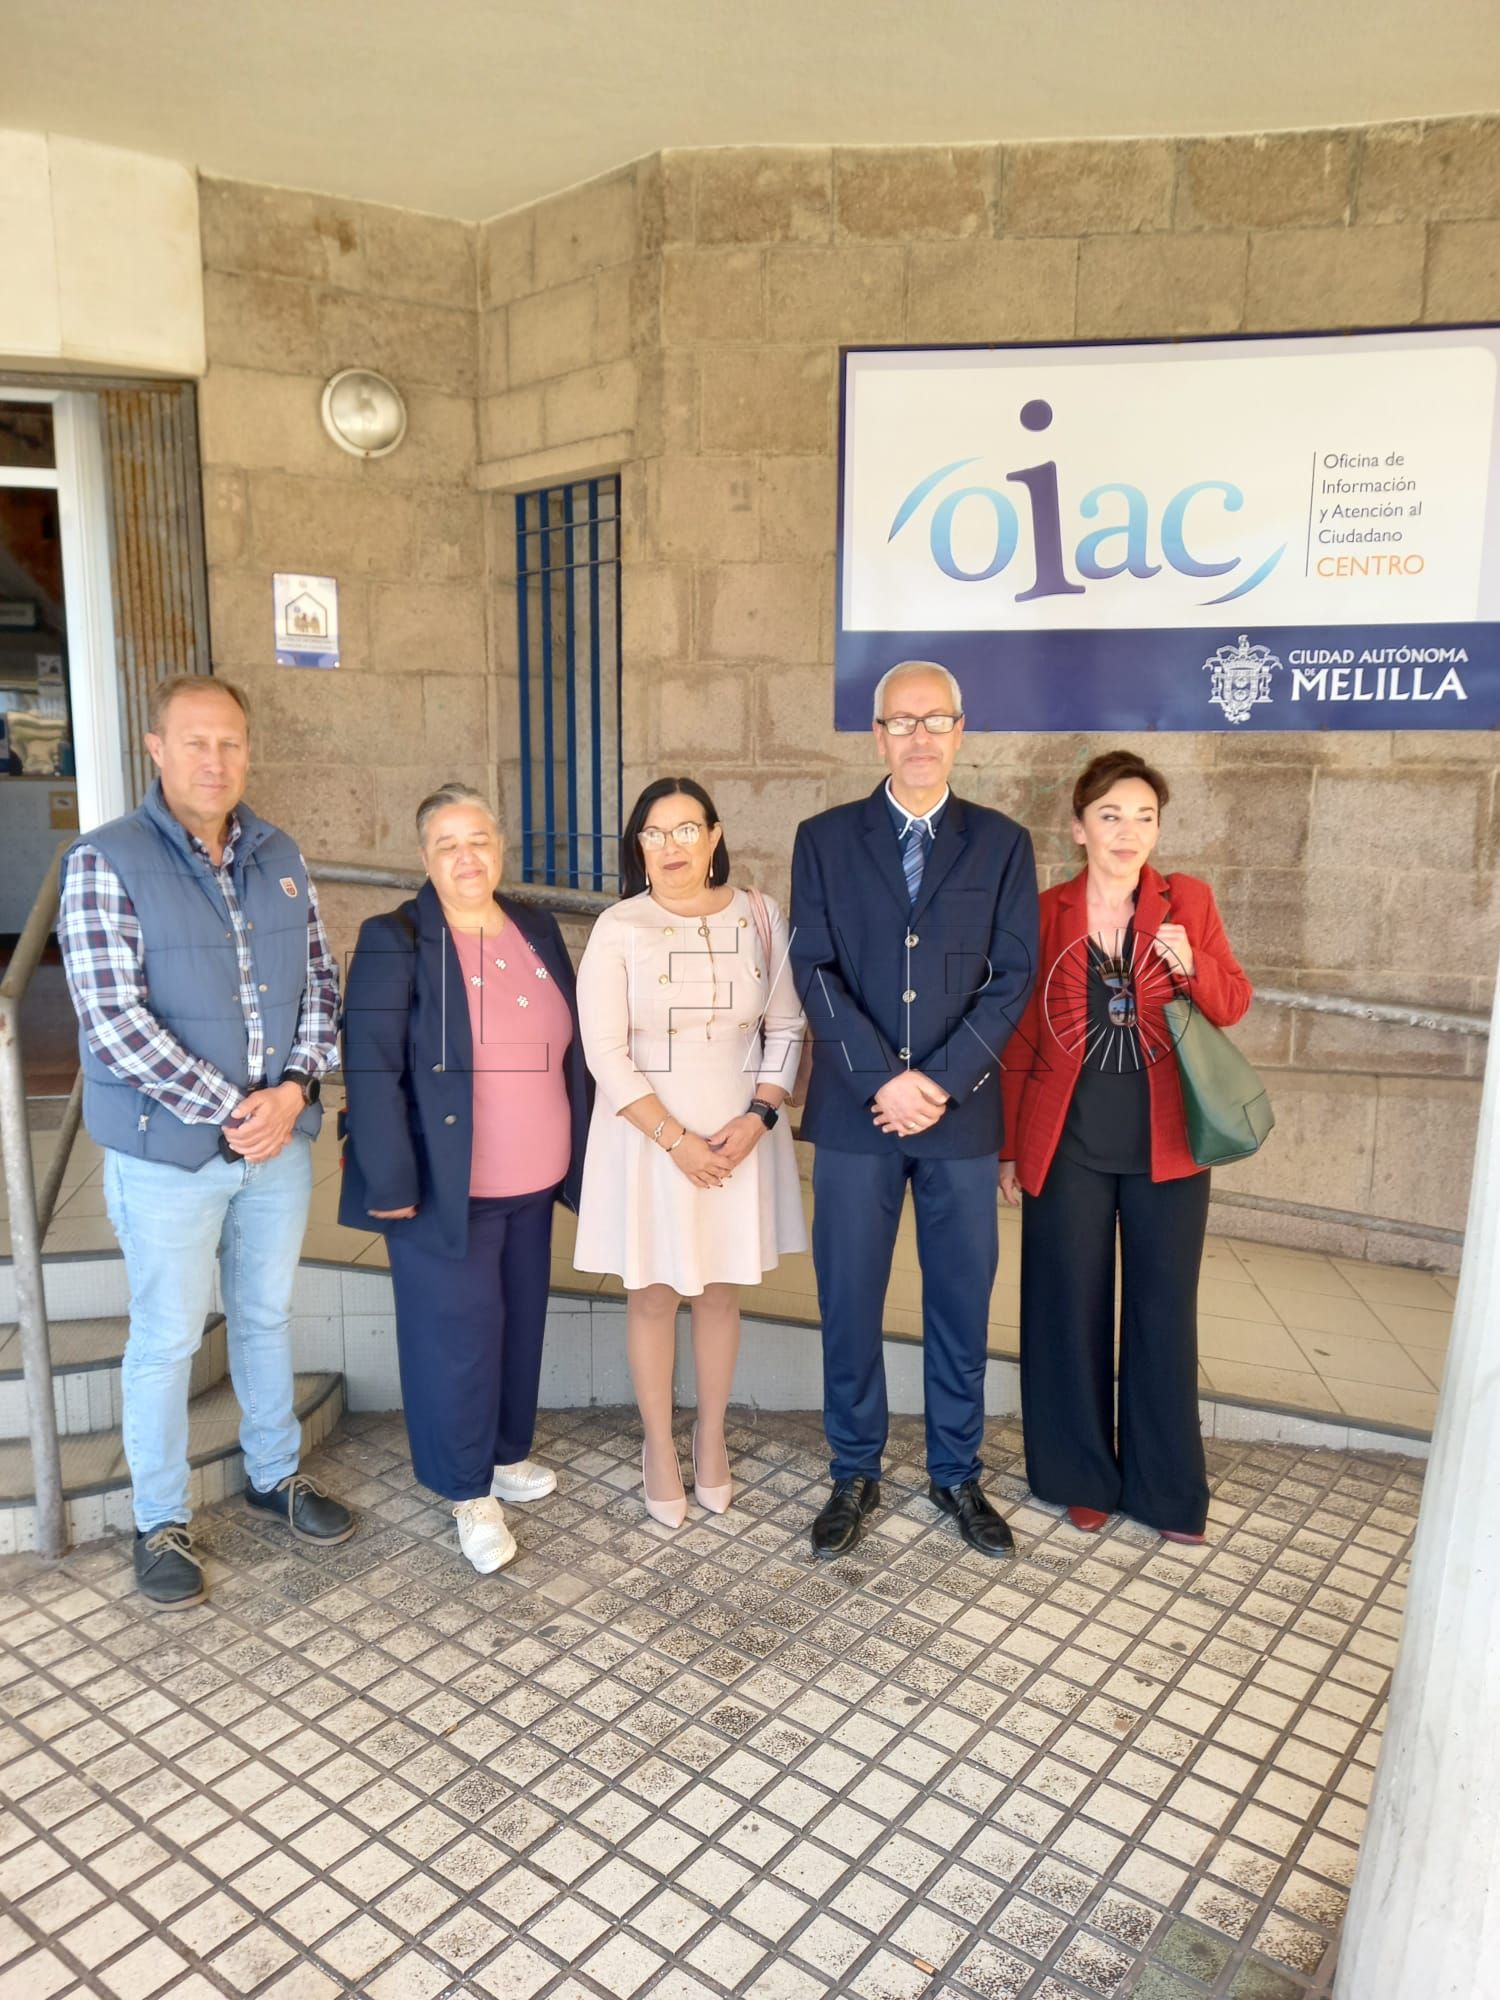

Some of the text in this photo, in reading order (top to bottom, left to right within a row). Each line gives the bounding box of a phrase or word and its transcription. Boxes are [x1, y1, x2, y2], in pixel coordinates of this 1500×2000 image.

[1323, 451, 1405, 469] Oficina de
[1321, 476, 1417, 494] Información
[1319, 501, 1422, 524] y Atención al
[1318, 528, 1403, 544] Ciudadano
[1316, 554, 1425, 577] CENTRO
[1288, 645, 1469, 665] CIUDAD AUTÓNOMA
[1304, 667, 1316, 677] DE
[1291, 667, 1468, 702] MELILLA
